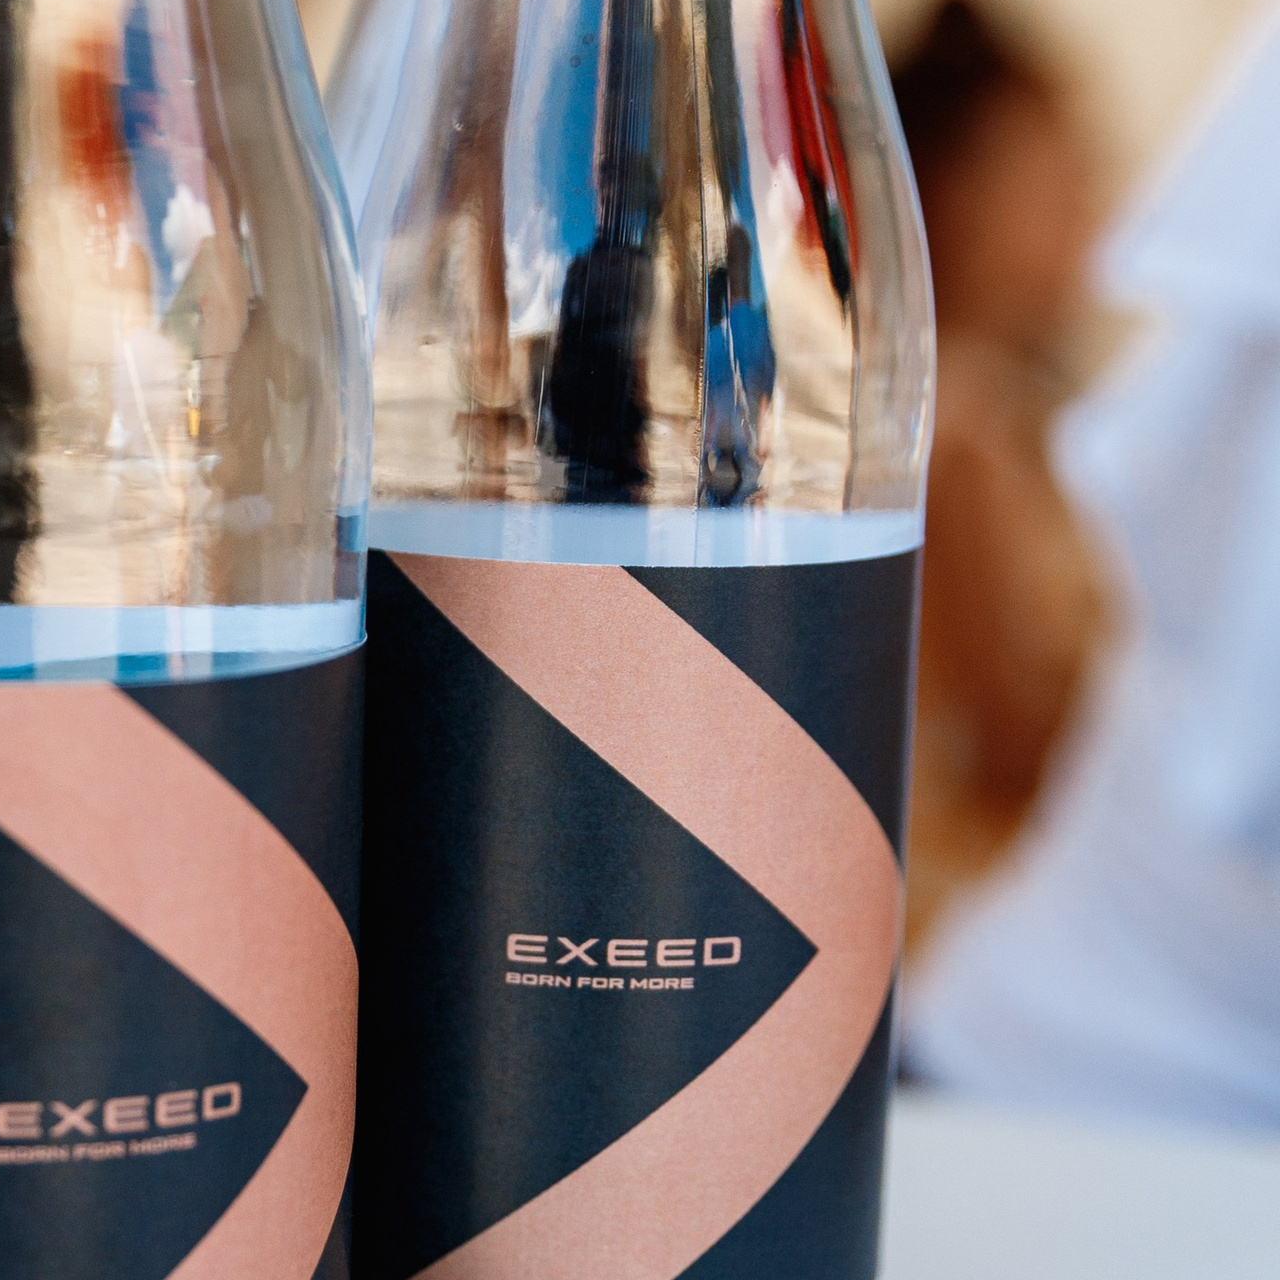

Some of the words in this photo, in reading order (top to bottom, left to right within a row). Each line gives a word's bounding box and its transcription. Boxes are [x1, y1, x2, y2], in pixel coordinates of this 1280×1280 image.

[506, 933, 742, 967] EXEED
[505, 972, 572, 988] BORN
[577, 975, 624, 990] FOR
[629, 977, 695, 991] MORE
